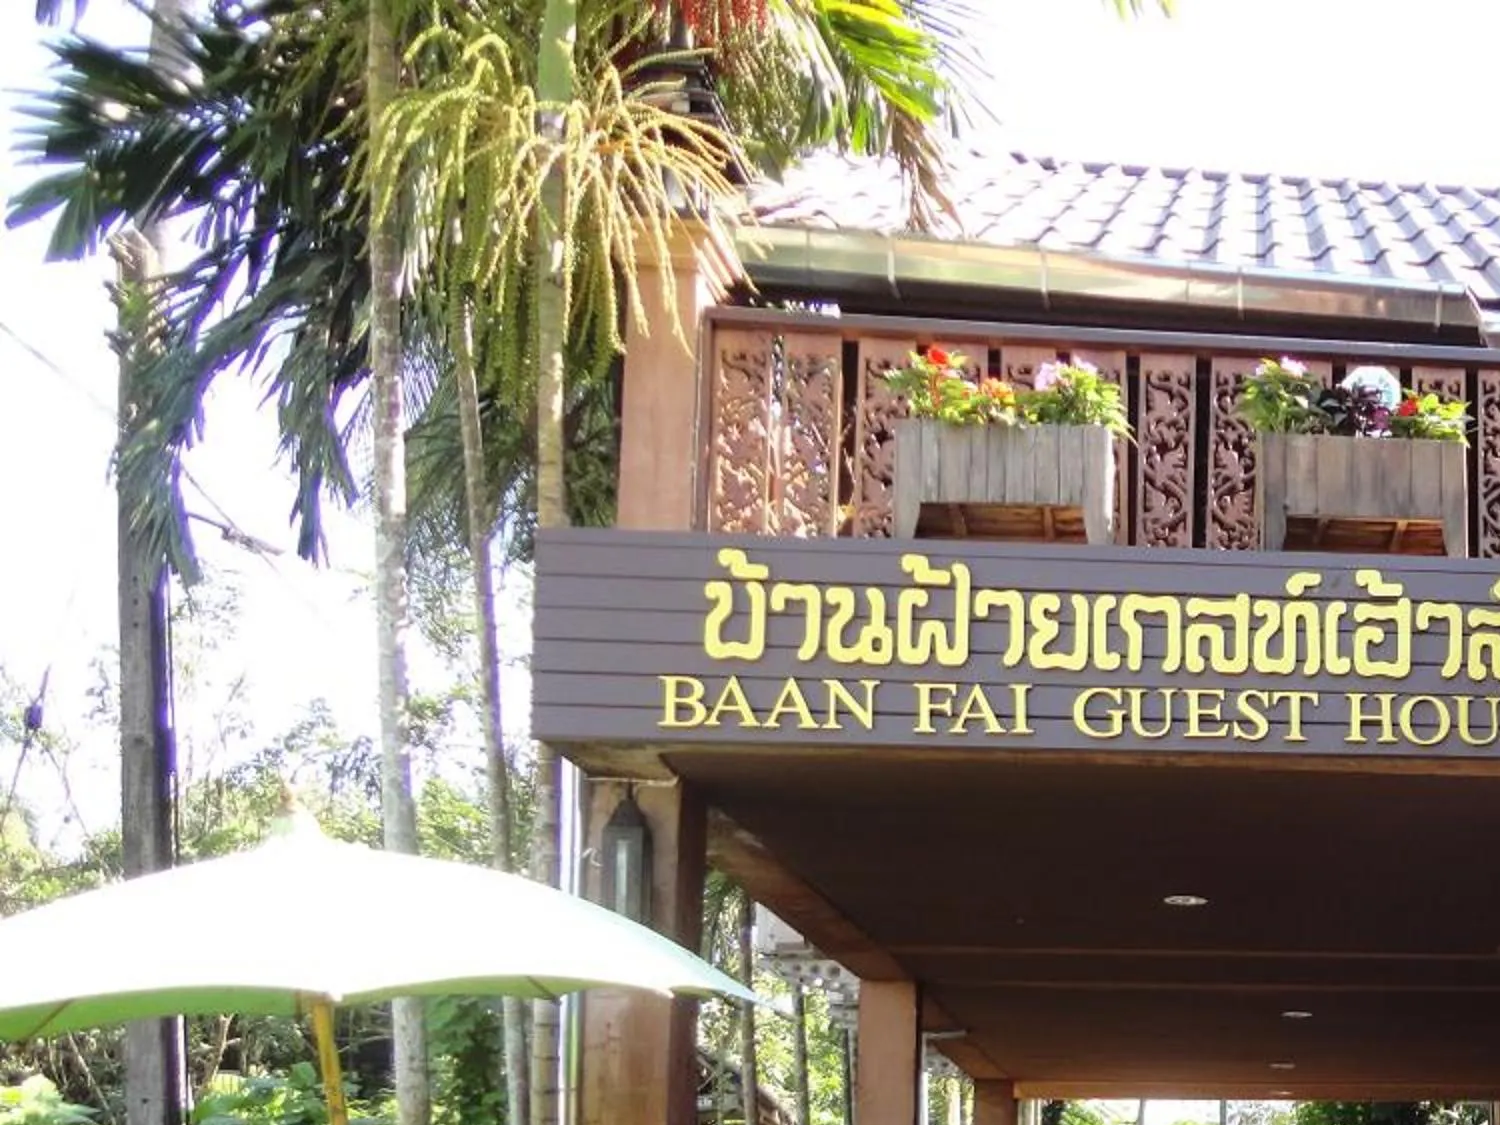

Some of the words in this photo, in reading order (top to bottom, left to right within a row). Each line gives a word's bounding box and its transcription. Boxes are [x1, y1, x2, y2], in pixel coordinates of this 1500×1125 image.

[658, 674, 878, 731] BAAN
[913, 683, 1034, 732] FAI
[1072, 686, 1320, 742] GUEST
